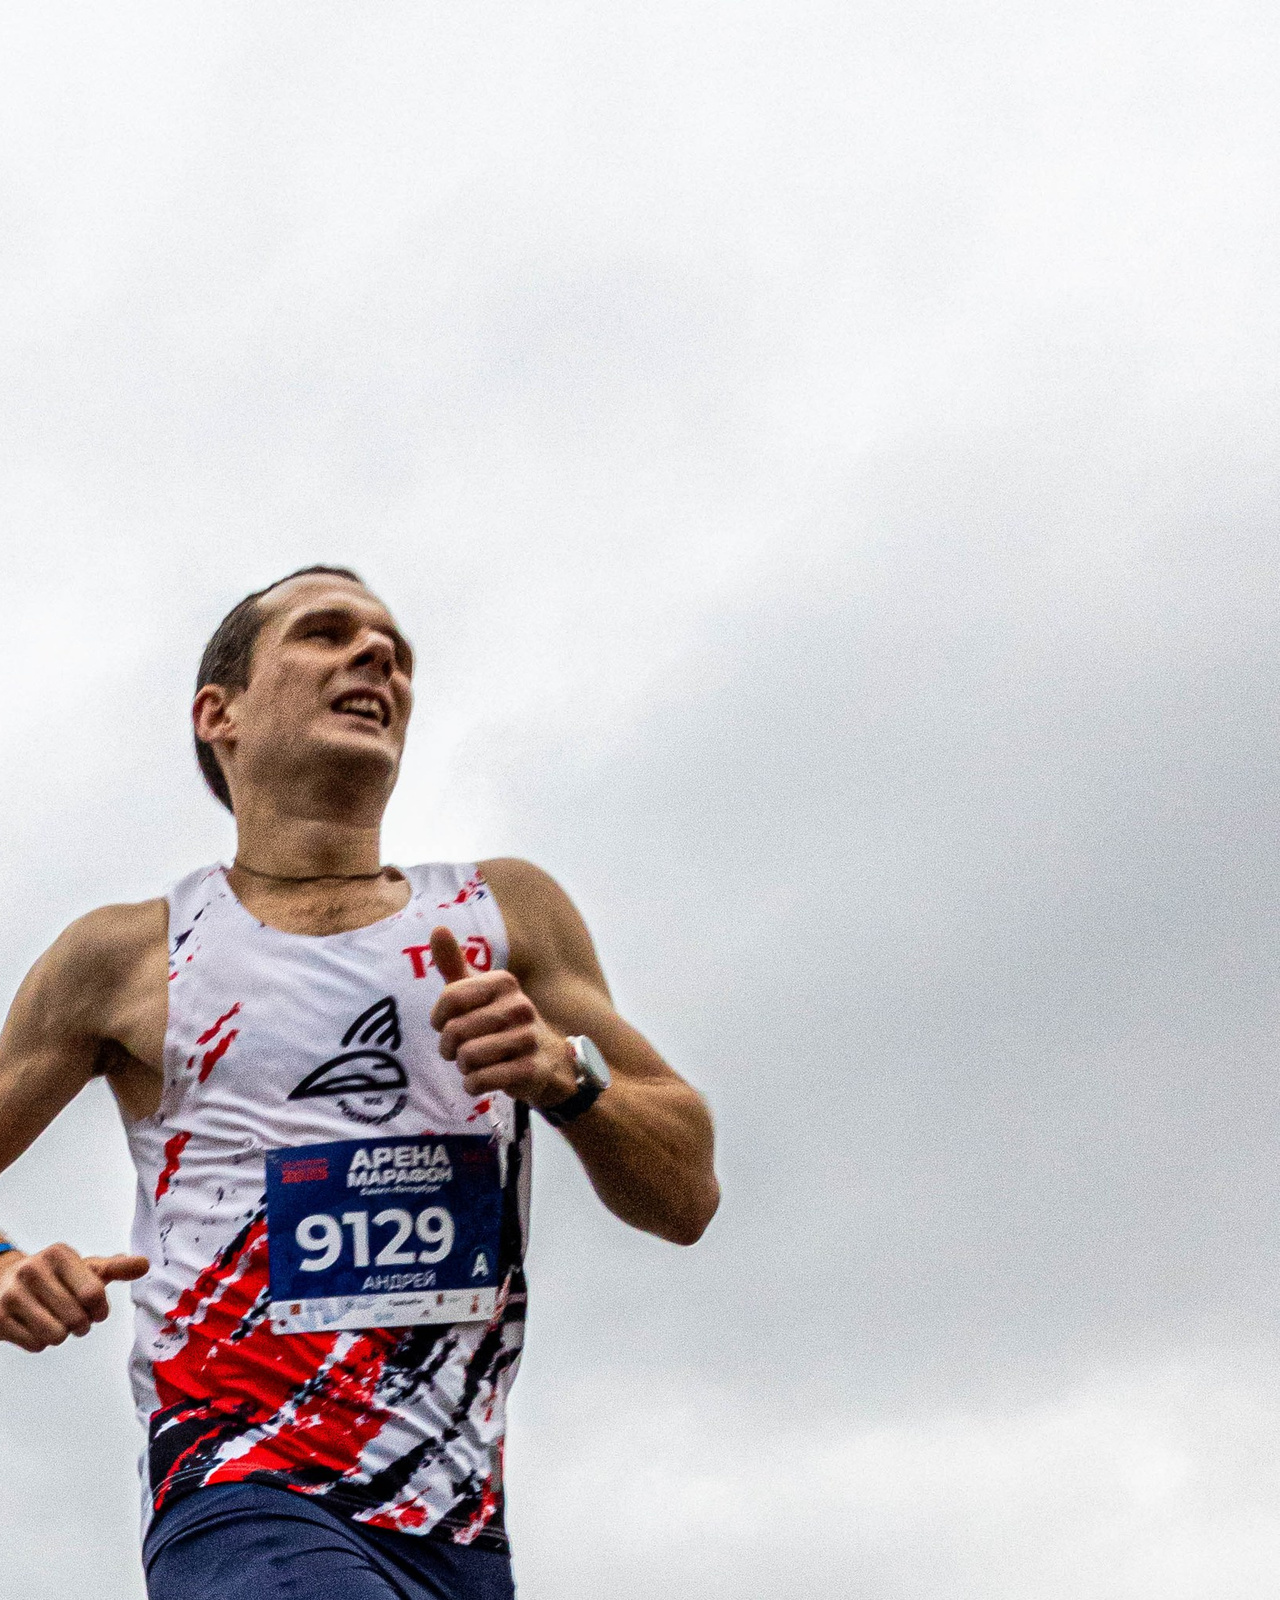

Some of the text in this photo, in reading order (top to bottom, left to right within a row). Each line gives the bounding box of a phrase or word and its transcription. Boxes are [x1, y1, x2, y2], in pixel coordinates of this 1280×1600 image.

[348, 1144, 452, 1172] АРЕНА
[346, 1166, 453, 1188] МАРАФОН
[295, 1206, 456, 1272] 9129
[361, 1270, 437, 1292] АНДРЕЙ
